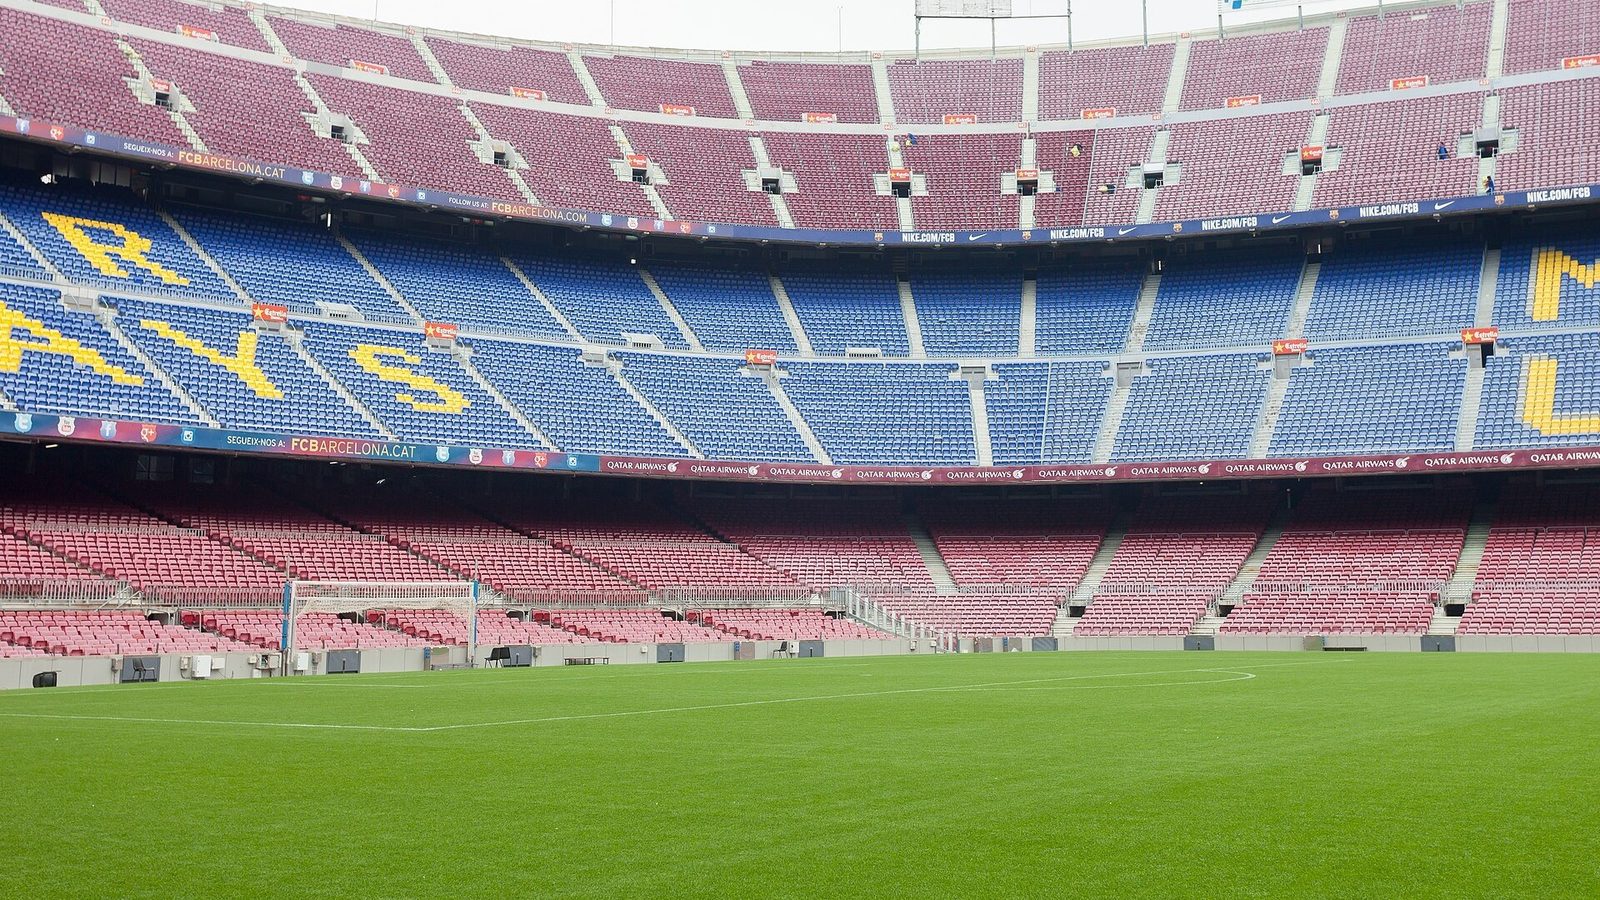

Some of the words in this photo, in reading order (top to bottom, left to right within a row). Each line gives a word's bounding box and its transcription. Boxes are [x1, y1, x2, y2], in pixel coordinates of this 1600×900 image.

[178, 150, 286, 179] FCBARCELONA.CAT
[1526, 187, 1591, 202] NIKE.COM/FCB
[448, 197, 471, 207] FOLLOW
[472, 200, 480, 208] US
[492, 202, 587, 223] FCBARCELONA.COM
[1359, 203, 1419, 217] NIKE.COM/FCB
[1202, 217, 1258, 231] NIKE.COM/FCB
[902, 233, 955, 243] NIKE.COM/FCB
[1050, 228, 1104, 239] NIKE.COM/FCB
[227, 435, 277, 447] SEGUEIX-NOS
[291, 438, 417, 458] FCBARCELONA.CAT
[1425, 458, 1457, 467] QATAR
[1458, 455, 1499, 465] AIRWAYS
[1531, 453, 1564, 462] QATAR
[608, 461, 633, 470] QATAR
[635, 462, 667, 471] AIRWAYS
[691, 464, 716, 473] QATAR
[717, 466, 748, 474] AIRWAYS
[1225, 464, 1255, 473] QATAR
[1256, 463, 1294, 471] AIRWAYS
[1323, 461, 1354, 470] QATAR
[1355, 460, 1394, 468] AIRWAYS
[770, 467, 797, 476] QATAR
[797, 469, 831, 477] AIRWAYS
[857, 470, 884, 479] QATAR
[947, 471, 975, 479] QATAR
[1039, 470, 1067, 478] QATAR
[1131, 467, 1160, 475] QATAR
[1161, 466, 1197, 474] AIRWAYS
